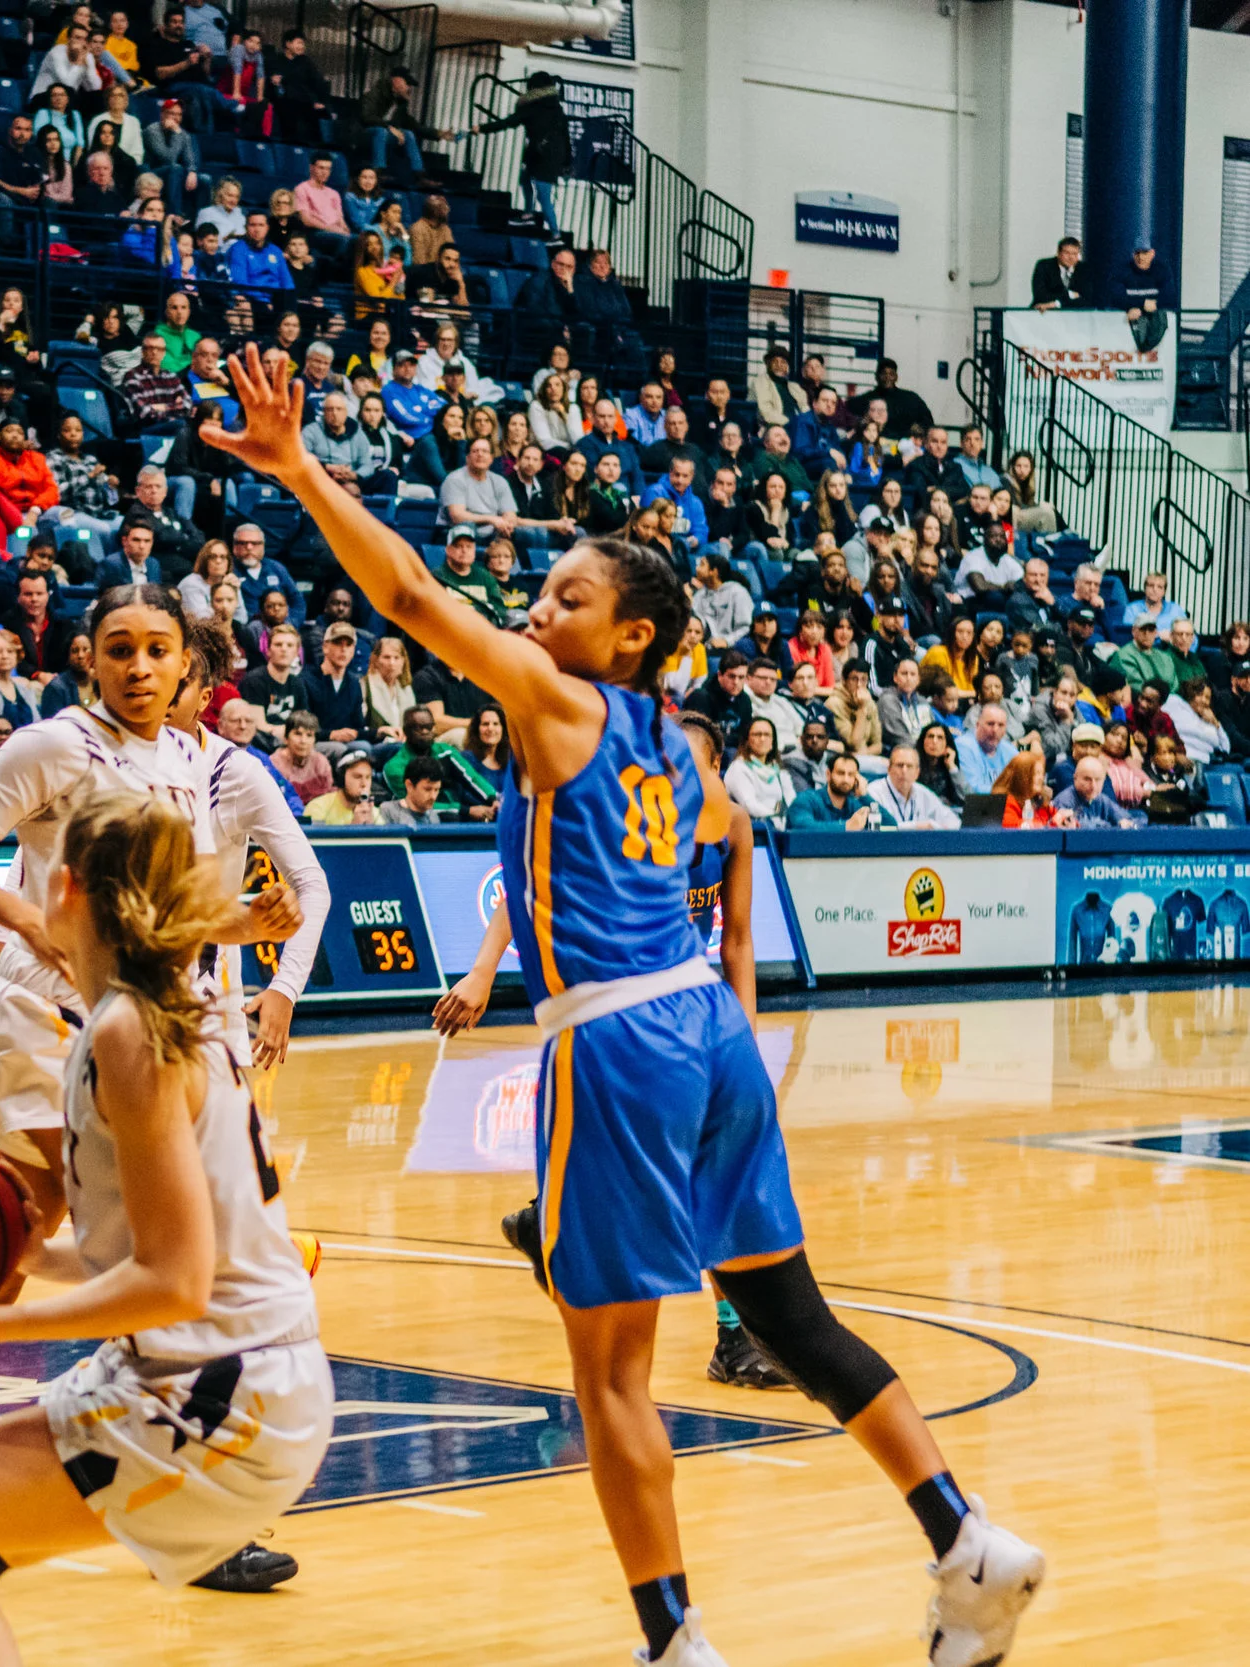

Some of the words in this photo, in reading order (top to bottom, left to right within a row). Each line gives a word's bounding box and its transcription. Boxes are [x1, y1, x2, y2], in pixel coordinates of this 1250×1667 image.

[1084, 864, 1166, 880] MONMOUTH
[1172, 864, 1227, 878] HAWKS
[350, 900, 403, 925] GUEST
[815, 907, 839, 922] One
[844, 906, 876, 922] Place.
[967, 902, 992, 918] Your
[997, 901, 1028, 918] Place.
[891, 922, 958, 958] ShopRite
[371, 930, 415, 972] 35
